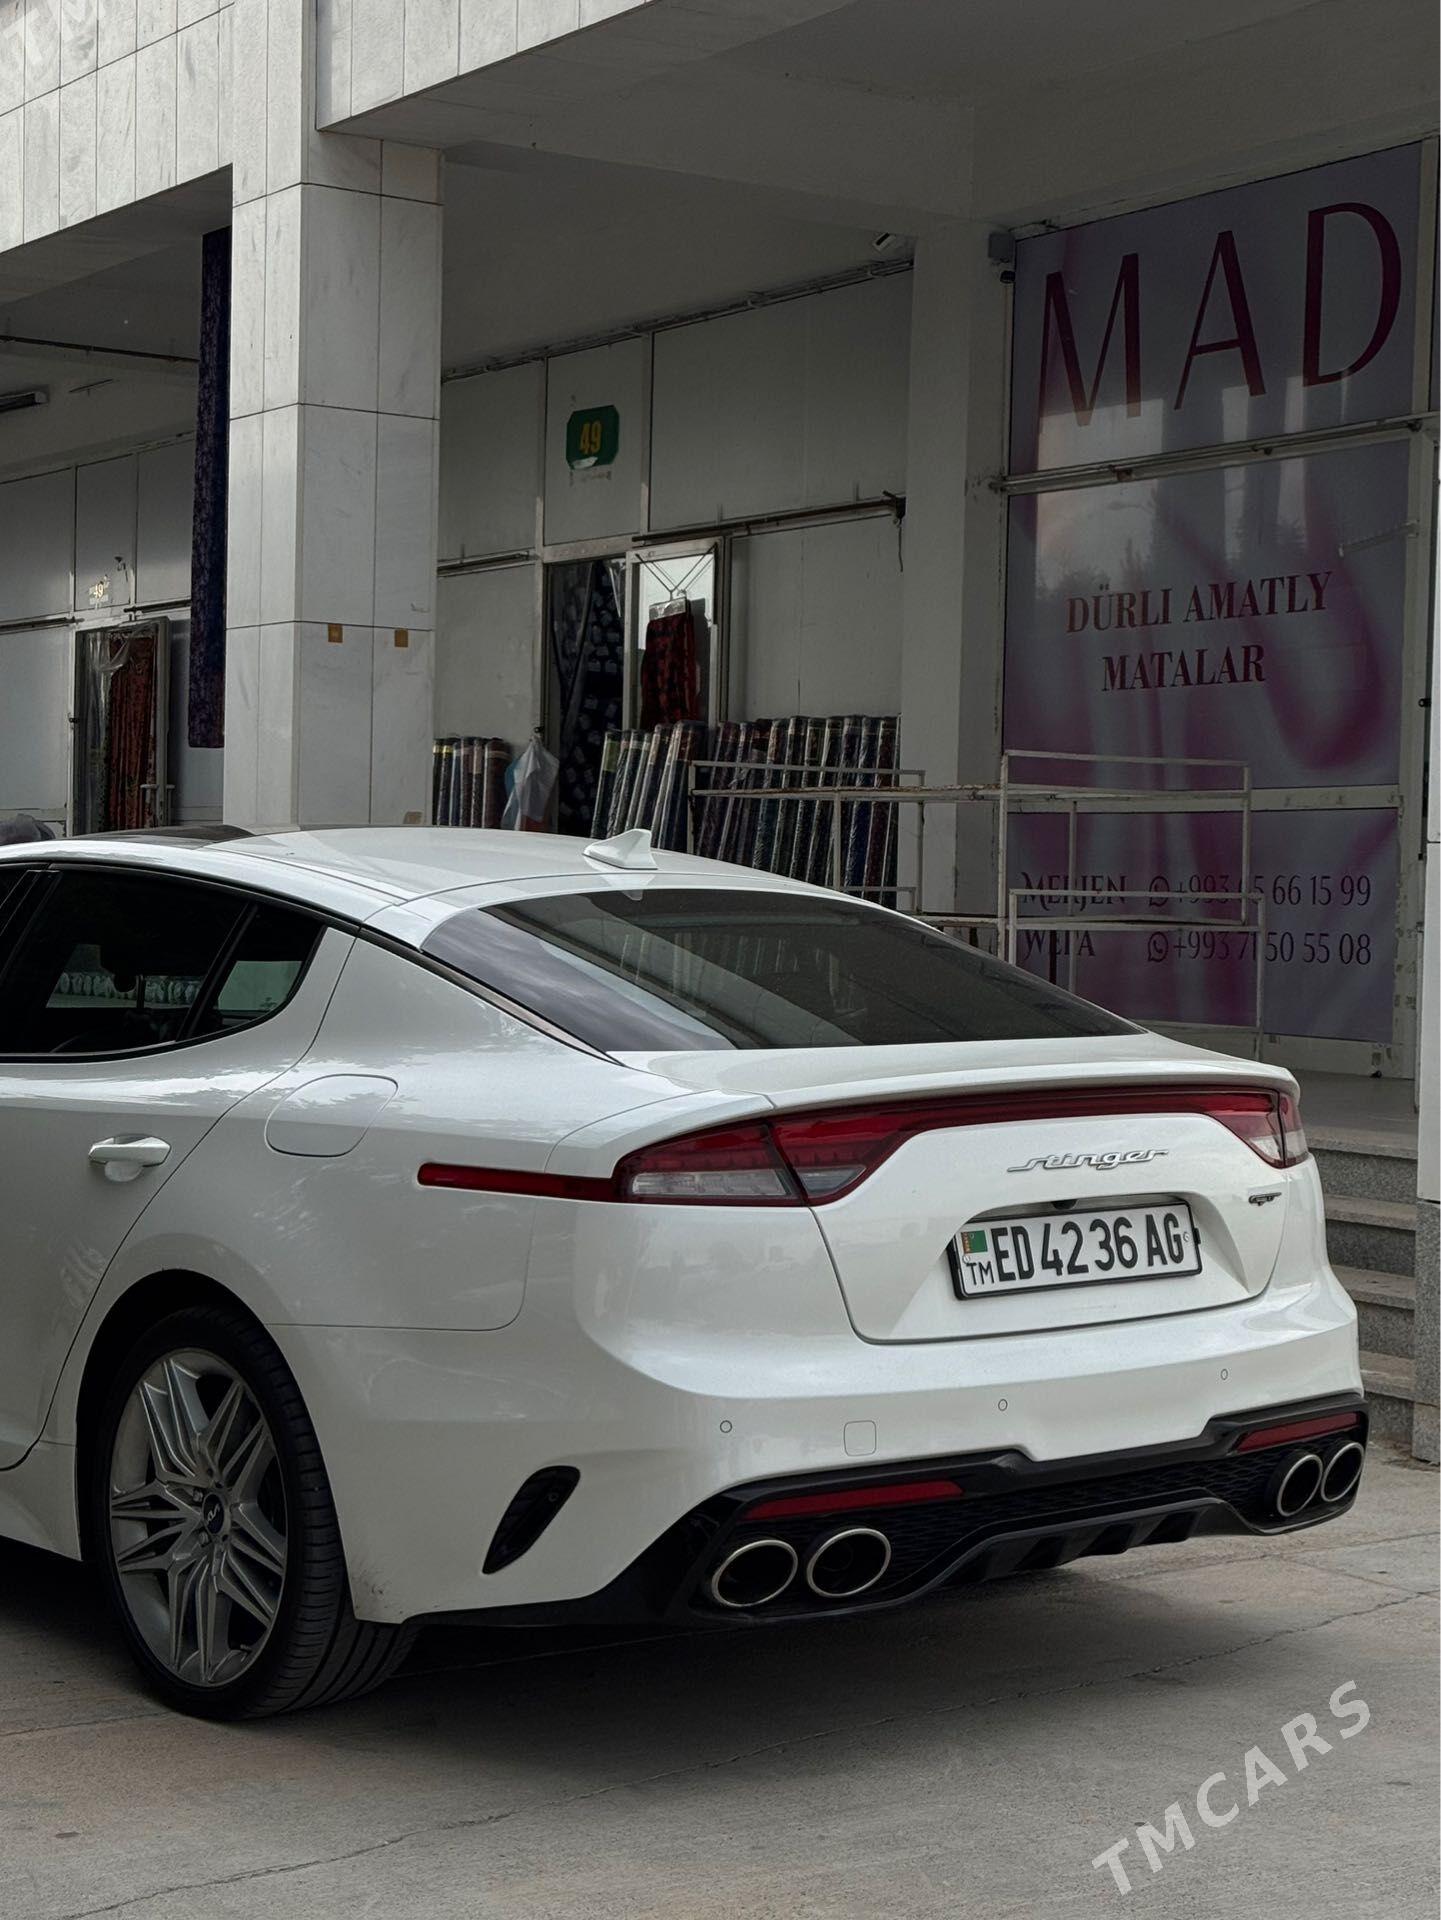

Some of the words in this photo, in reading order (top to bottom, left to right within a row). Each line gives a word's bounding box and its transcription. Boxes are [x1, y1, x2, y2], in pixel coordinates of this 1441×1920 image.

[1038, 203, 1402, 436] MAD
[579, 421, 602, 455] 49
[1067, 583, 1173, 633] DÜRLI
[1182, 571, 1332, 623] AMATLY
[1101, 644, 1266, 691] MATALAR
[1272, 874, 1301, 905] 66
[1310, 874, 1332, 906] 15
[1340, 875, 1371, 906] 99
[1173, 930, 1231, 961] +993
[1265, 931, 1294, 962] 50
[1303, 932, 1331, 964] 55
[1339, 933, 1372, 965] 08
[966, 1260, 996, 1286] TM
[990, 1225, 1035, 1283] ED
[1040, 1216, 1138, 1276] 4236
[1145, 1212, 1184, 1267] AG
